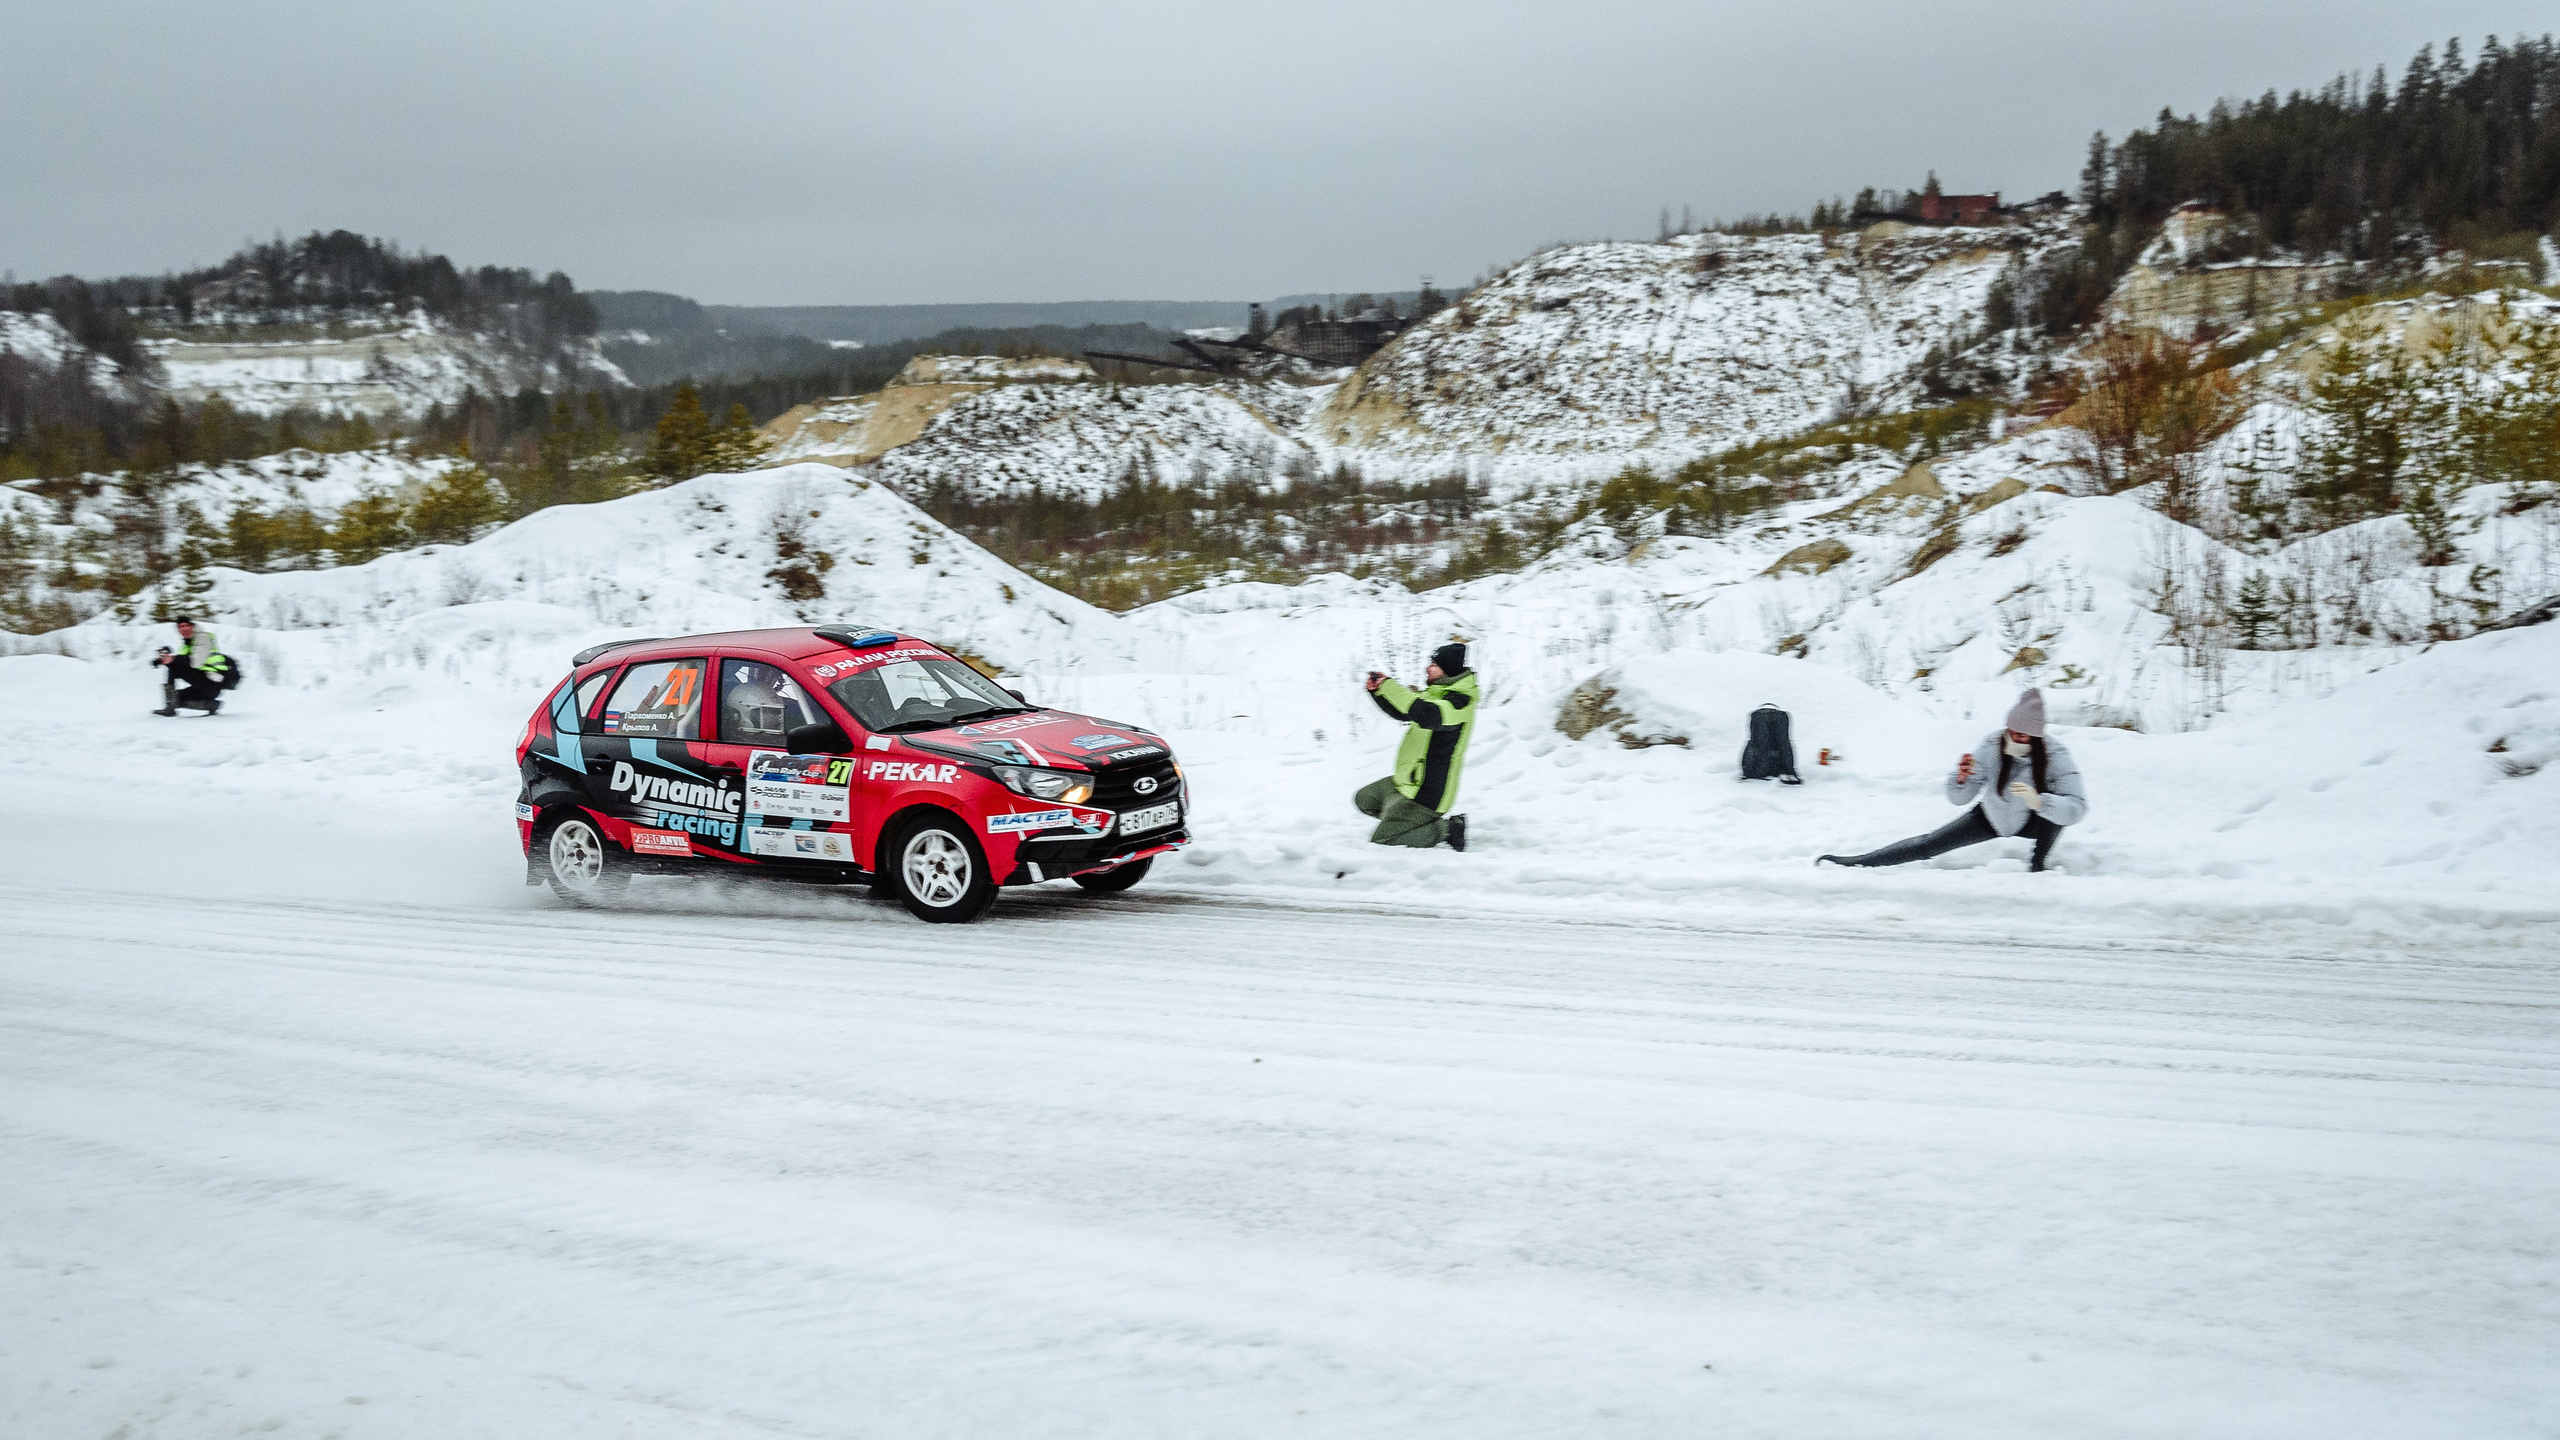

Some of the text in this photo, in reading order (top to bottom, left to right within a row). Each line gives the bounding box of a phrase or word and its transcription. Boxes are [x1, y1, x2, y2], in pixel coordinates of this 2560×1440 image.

[834, 652, 887, 671] РАЛЛИ
[663, 668, 698, 706] 27
[624, 711, 667, 721] Пархоменко
[801, 768, 819, 778] Cup
[827, 761, 853, 785] 27
[610, 761, 742, 813] Dynamic
[656, 809, 737, 846] racing
[991, 811, 1069, 826] МАСТЕР
